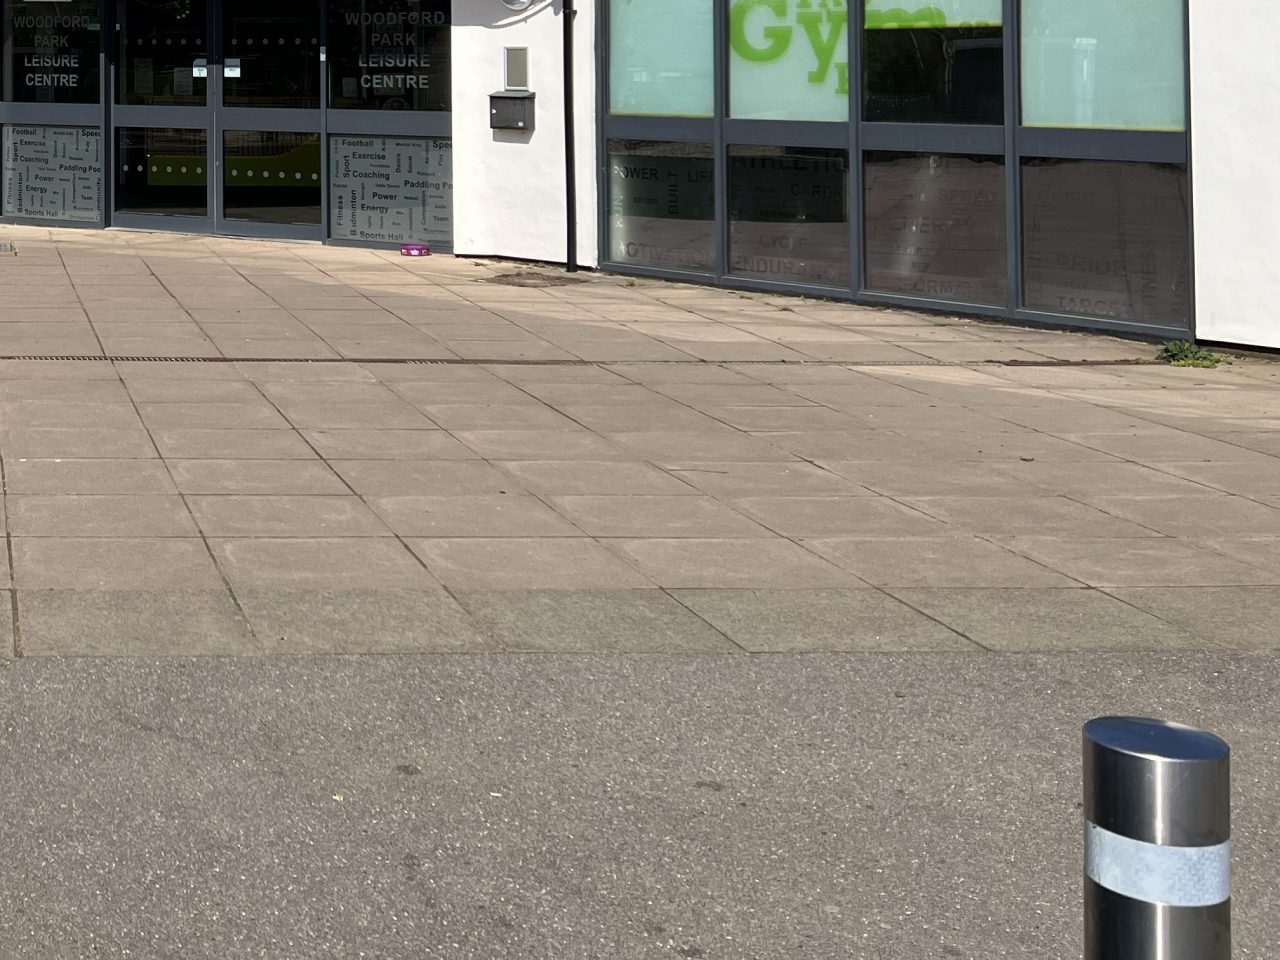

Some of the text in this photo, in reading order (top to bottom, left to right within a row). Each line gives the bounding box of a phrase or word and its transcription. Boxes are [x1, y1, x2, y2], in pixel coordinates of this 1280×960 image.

[14, 16, 90, 29] WOODFORD
[345, 11, 445, 25] WOODFORD
[34, 35, 69, 48] PARK
[372, 33, 416, 46] PARK
[24, 55, 79, 67] LEISURE
[359, 54, 431, 68] LEISURE
[25, 74, 79, 87] CENTRE
[361, 75, 429, 88] CENTRE
[12, 128, 37, 136] Football
[342, 139, 374, 148] Football
[432, 140, 452, 150] Spe
[20, 155, 49, 165] Coaching
[352, 152, 386, 161] Exercise
[59, 164, 87, 174] Paddling
[35, 174, 54, 182] Power
[352, 170, 390, 181] Coaching
[25, 184, 47, 194] Energy
[404, 180, 441, 191] Paddling
[372, 192, 398, 201] Power
[24, 209, 45, 218] Sports
[361, 203, 389, 214] Energy
[359, 231, 404, 241] Sports Hall
